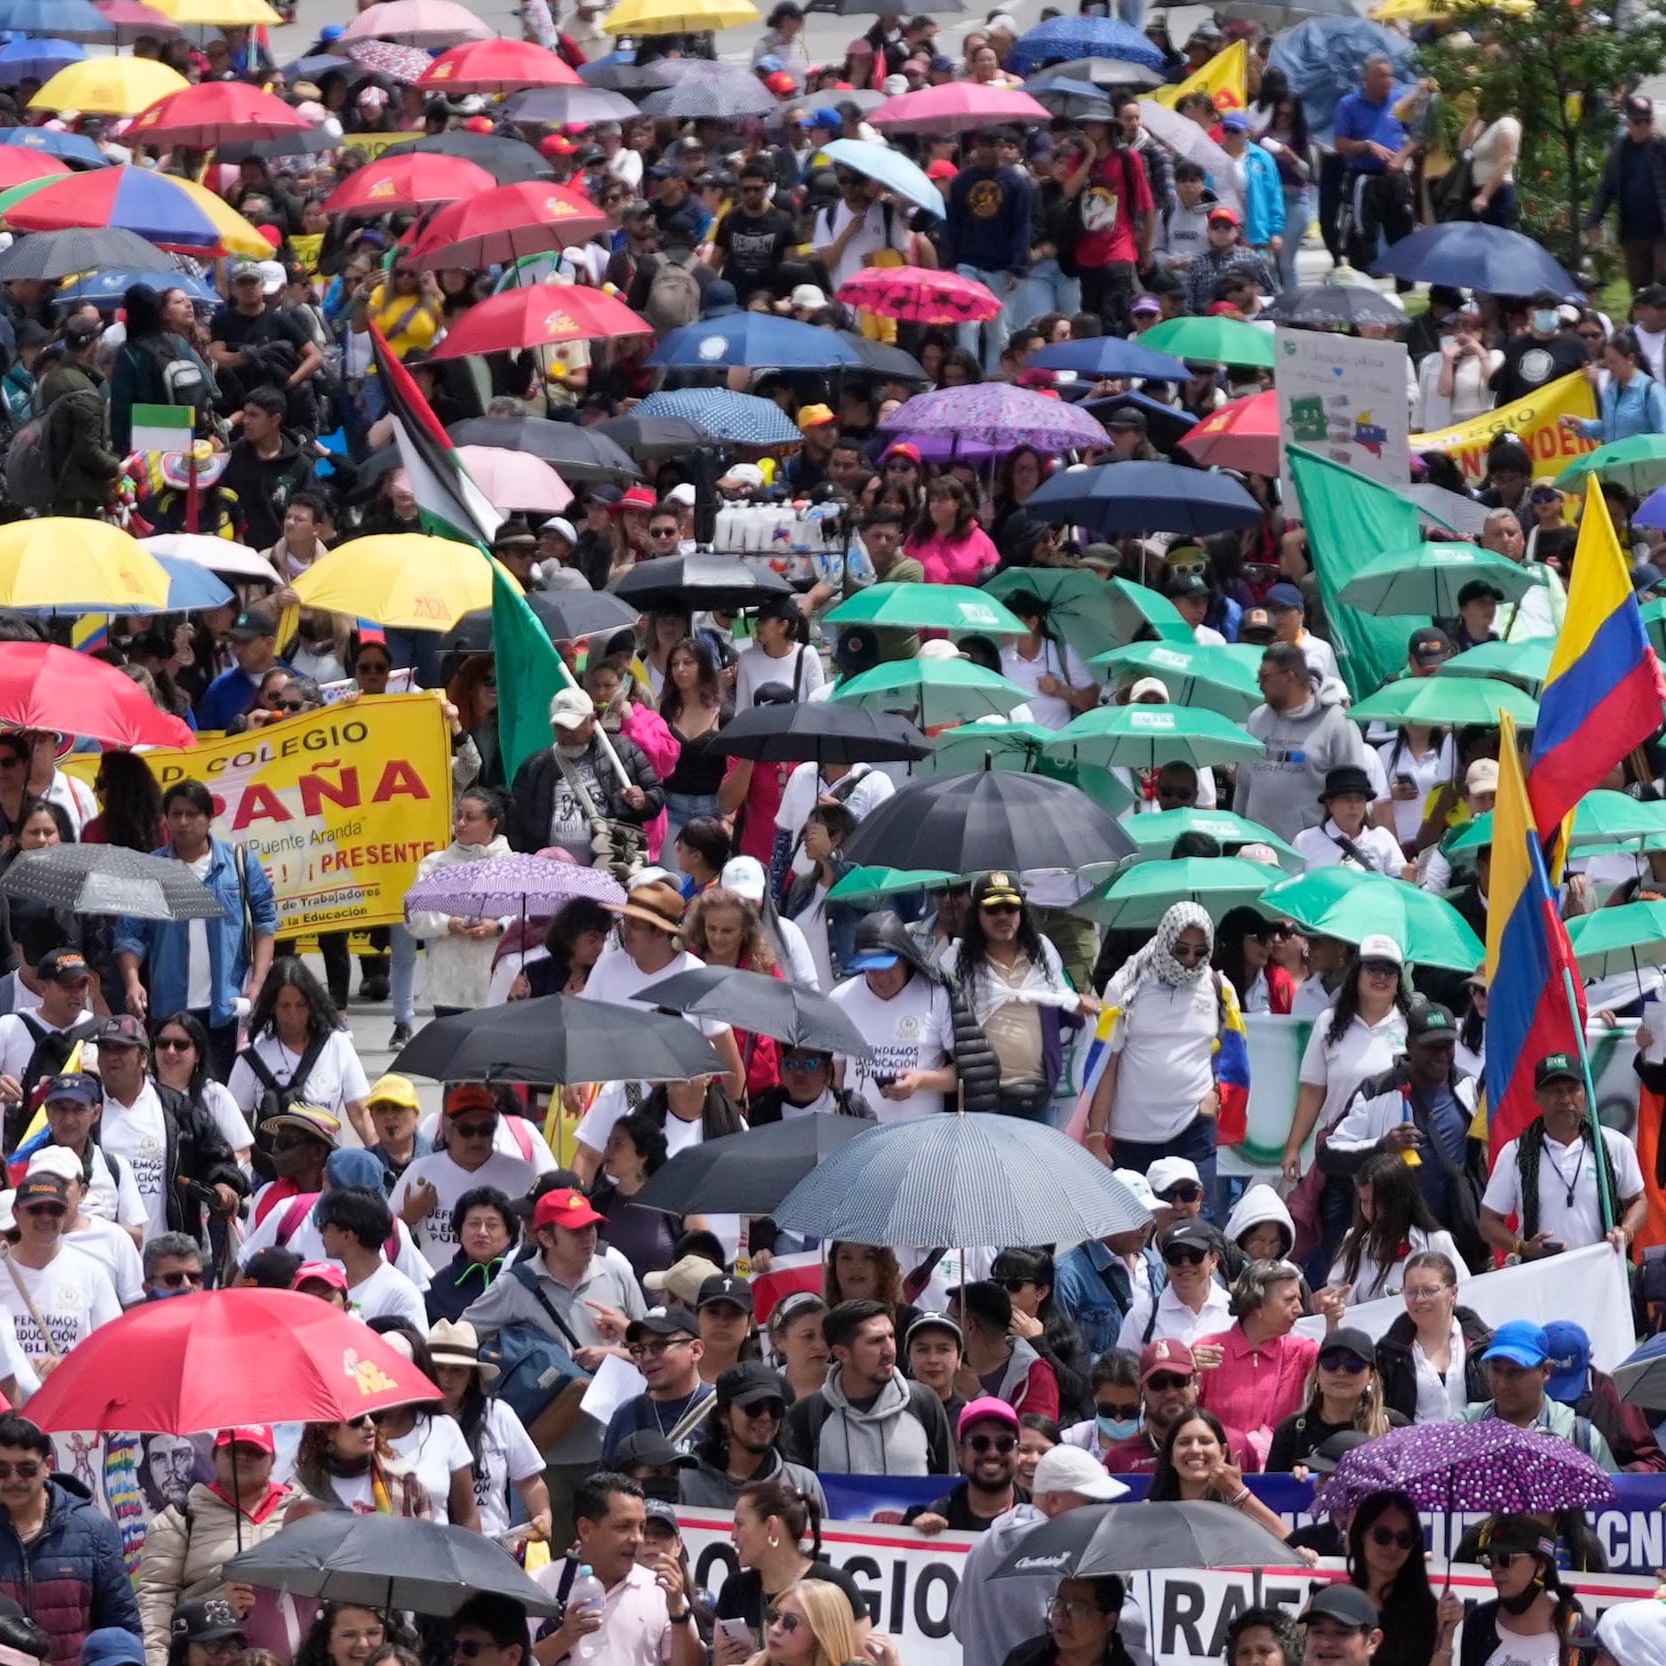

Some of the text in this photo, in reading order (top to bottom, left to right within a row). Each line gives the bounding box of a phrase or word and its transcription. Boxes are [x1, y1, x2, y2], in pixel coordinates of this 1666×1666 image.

[206, 720, 370, 784] COLEGIO
[210, 758, 432, 832] AÑA
[302, 887, 381, 909] Trabajadores
[302, 907, 369, 925] Educación
